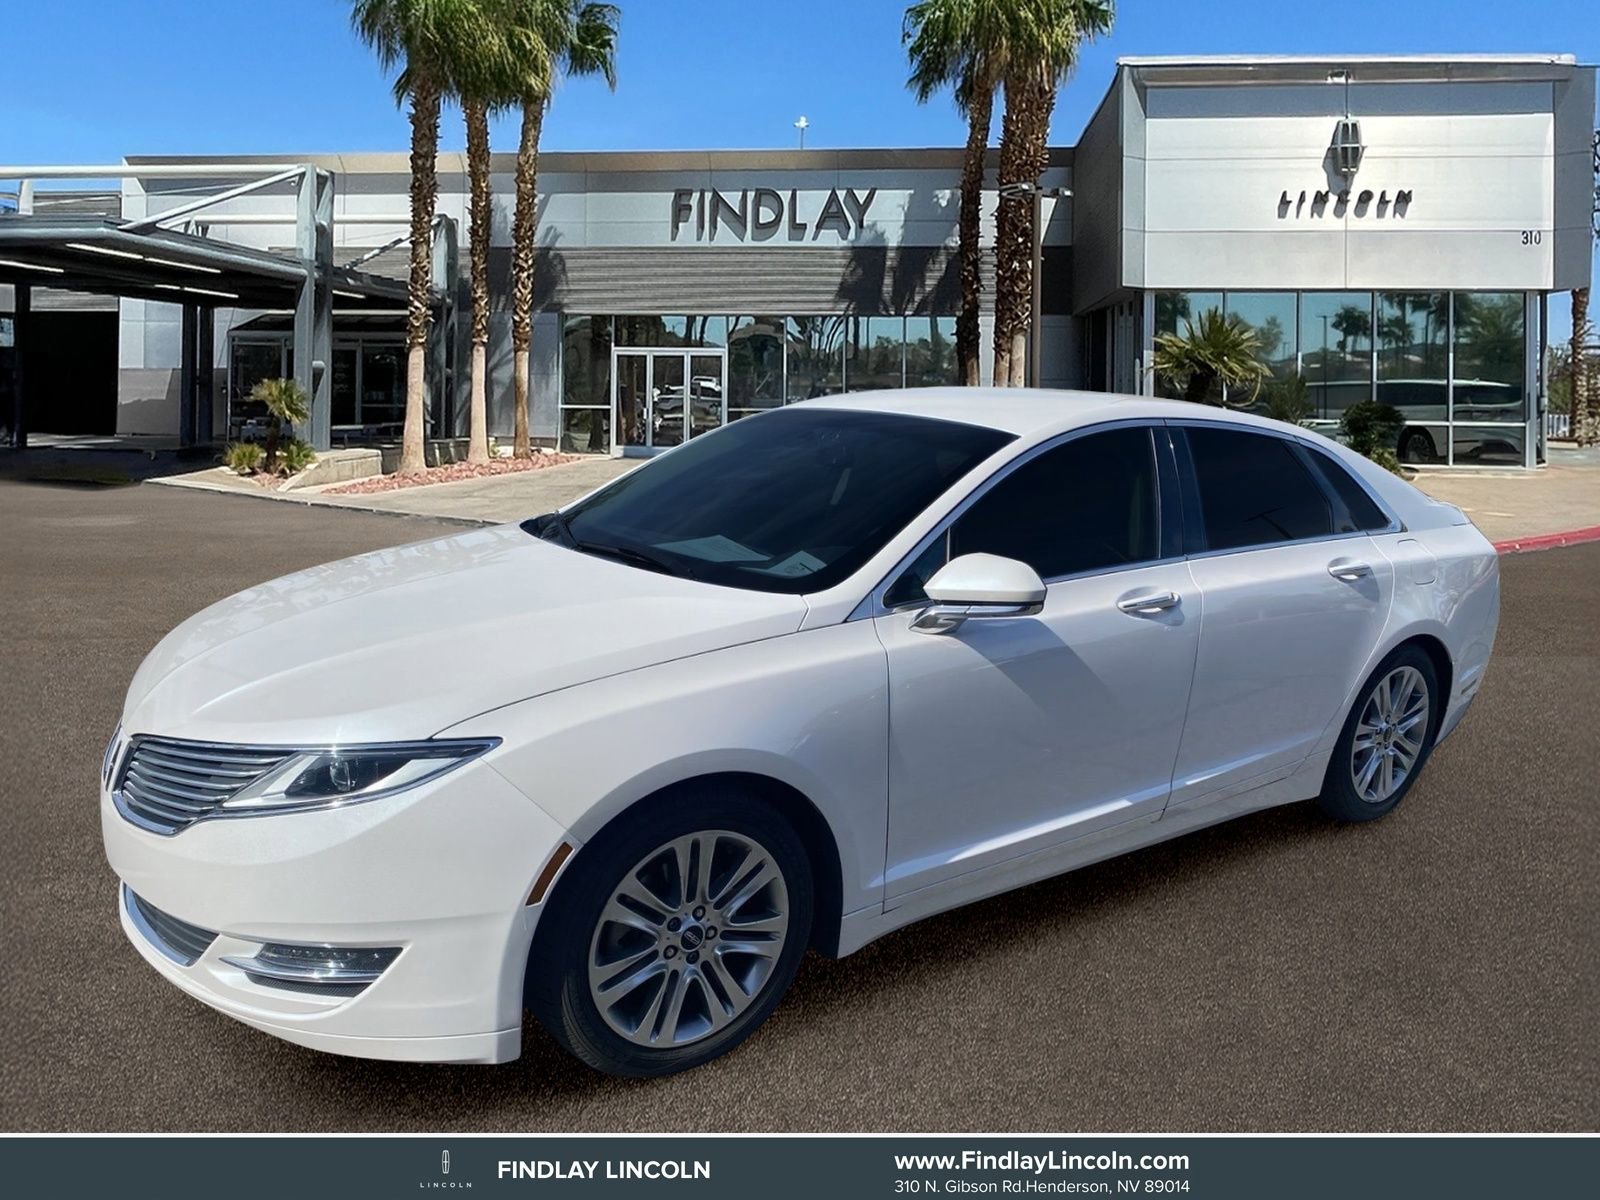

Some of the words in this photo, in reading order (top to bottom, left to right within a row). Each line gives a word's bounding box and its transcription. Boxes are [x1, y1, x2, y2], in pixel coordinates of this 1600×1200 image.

[671, 187, 877, 240] FINDLAY
[1278, 189, 1412, 214] LINCOLN
[1521, 231, 1542, 246] 310
